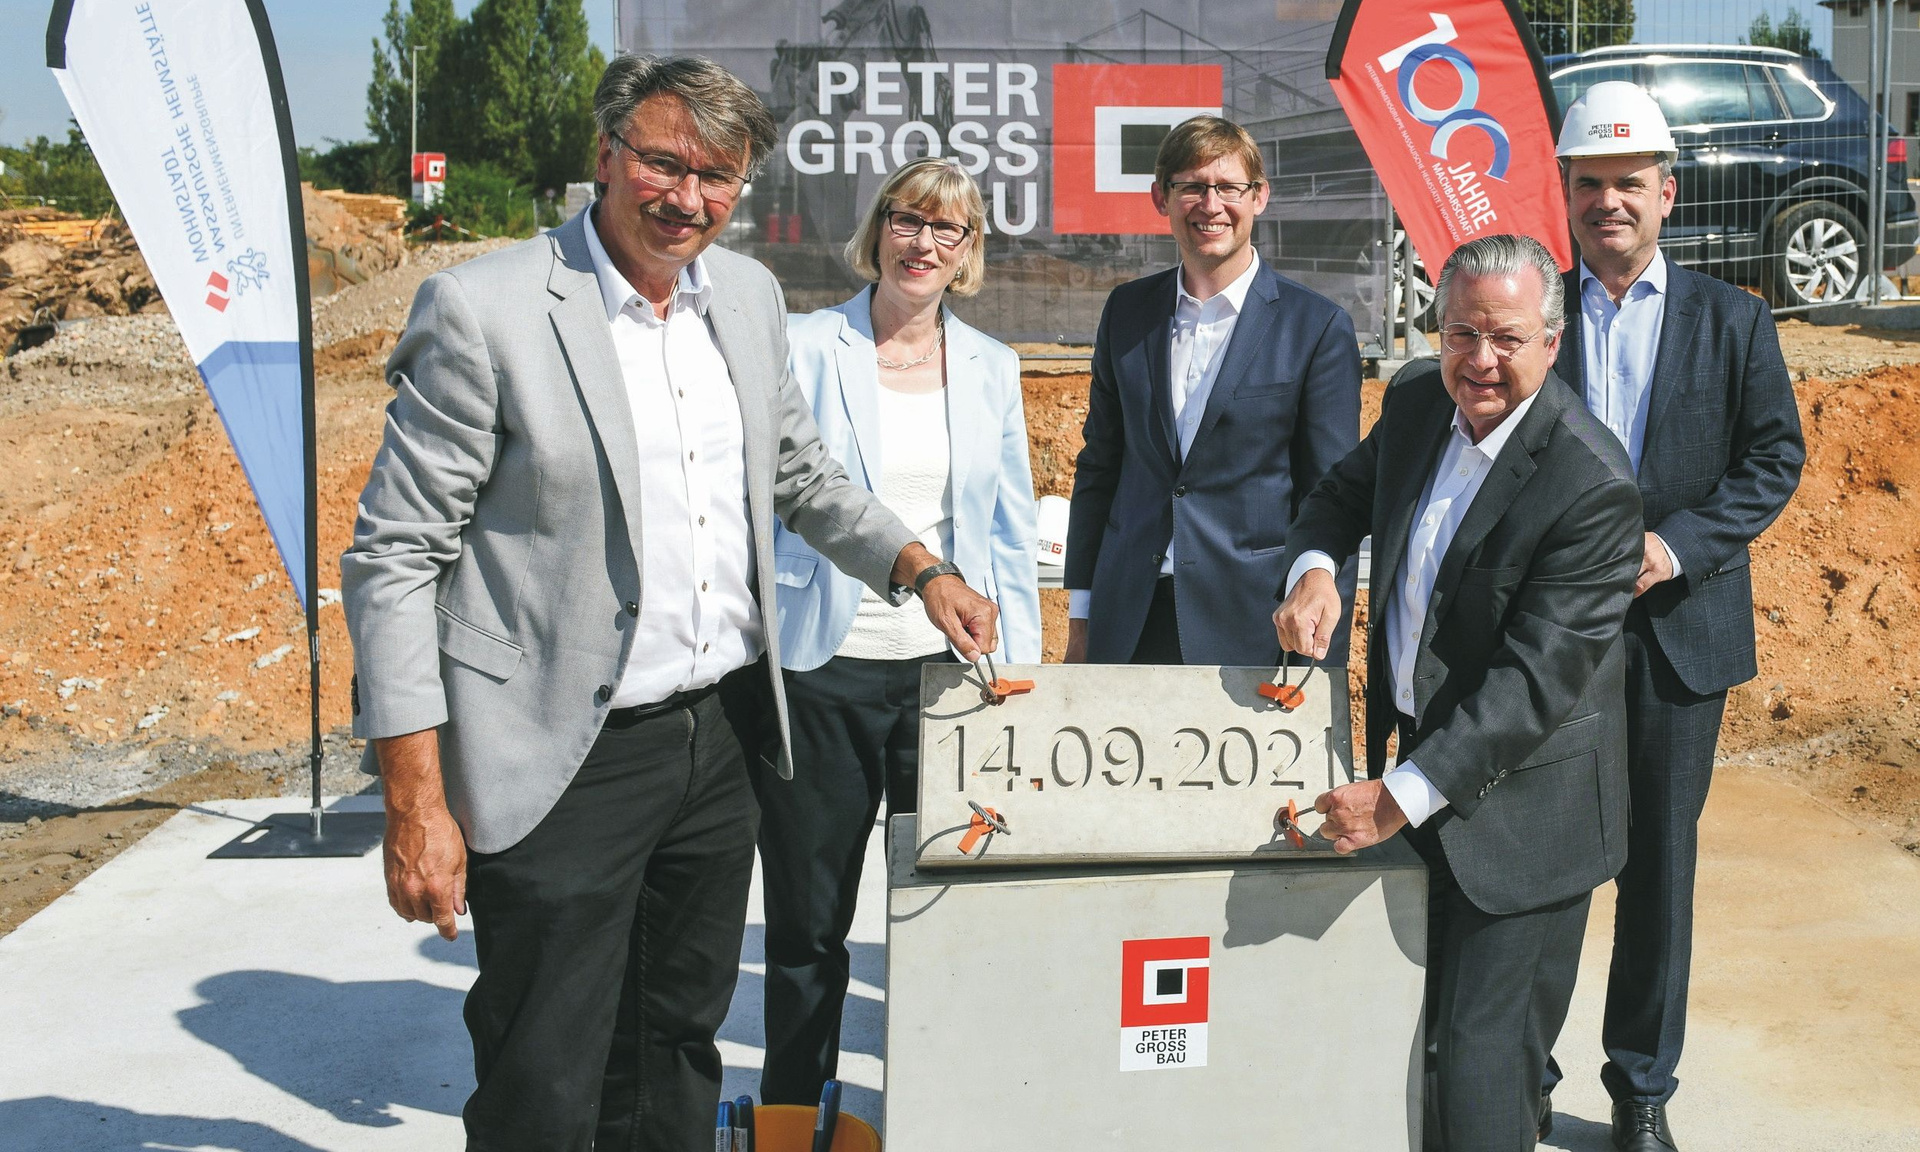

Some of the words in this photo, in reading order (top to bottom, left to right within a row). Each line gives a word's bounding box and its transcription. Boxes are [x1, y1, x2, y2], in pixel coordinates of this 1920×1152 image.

[817, 60, 1041, 117] PETER
[1588, 127, 1612, 136] GROSS
[1591, 123, 1612, 131] PETER
[786, 119, 1040, 176] GROSS
[1431, 162, 1475, 236] MACHBARSCHAFT
[1447, 161, 1497, 231] JAHRE
[937, 724, 1335, 792] 14.09.2021
[1135, 1040, 1187, 1054] GROSS
[1142, 1028, 1187, 1042] PETER
[1156, 1052, 1186, 1065] BAU
